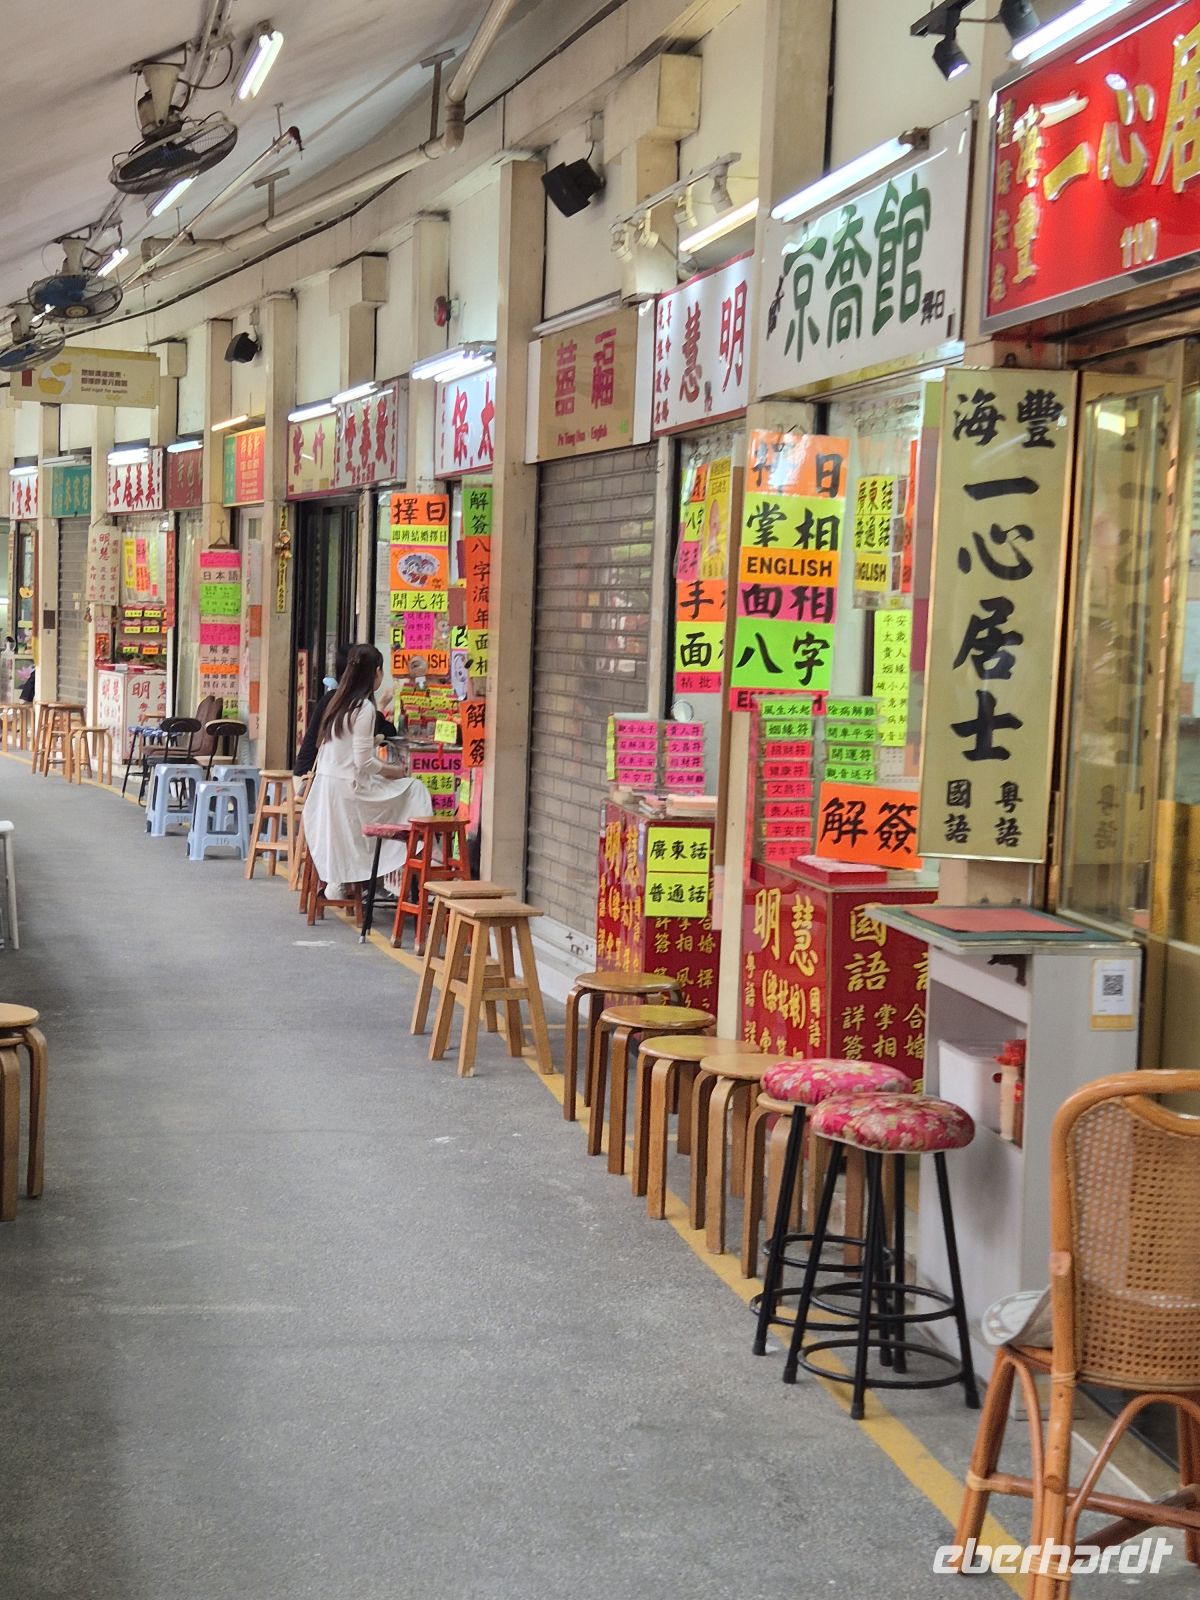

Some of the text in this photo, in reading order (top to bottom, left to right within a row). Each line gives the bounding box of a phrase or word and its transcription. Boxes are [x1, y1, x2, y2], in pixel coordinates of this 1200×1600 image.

[392, 497, 447, 525] 擇日
[746, 501, 841, 551] 掌相
[203, 570, 238, 581] 日本語
[746, 556, 833, 577] ENGLISH
[392, 592, 446, 611] 開光符
[741, 583, 836, 624] 面相
[950, 475, 1040, 763] 一心居士
[393, 654, 447, 669] ENISH
[735, 631, 831, 687] 八字
[415, 775, 453, 791] 通話
[944, 779, 972, 844] 國語
[993, 780, 1024, 847] 粵語
[649, 839, 709, 861] 廣東話
[648, 882, 707, 905] 普通話
[753, 887, 819, 977] 明慧
[872, 1002, 898, 1060] 掌相
